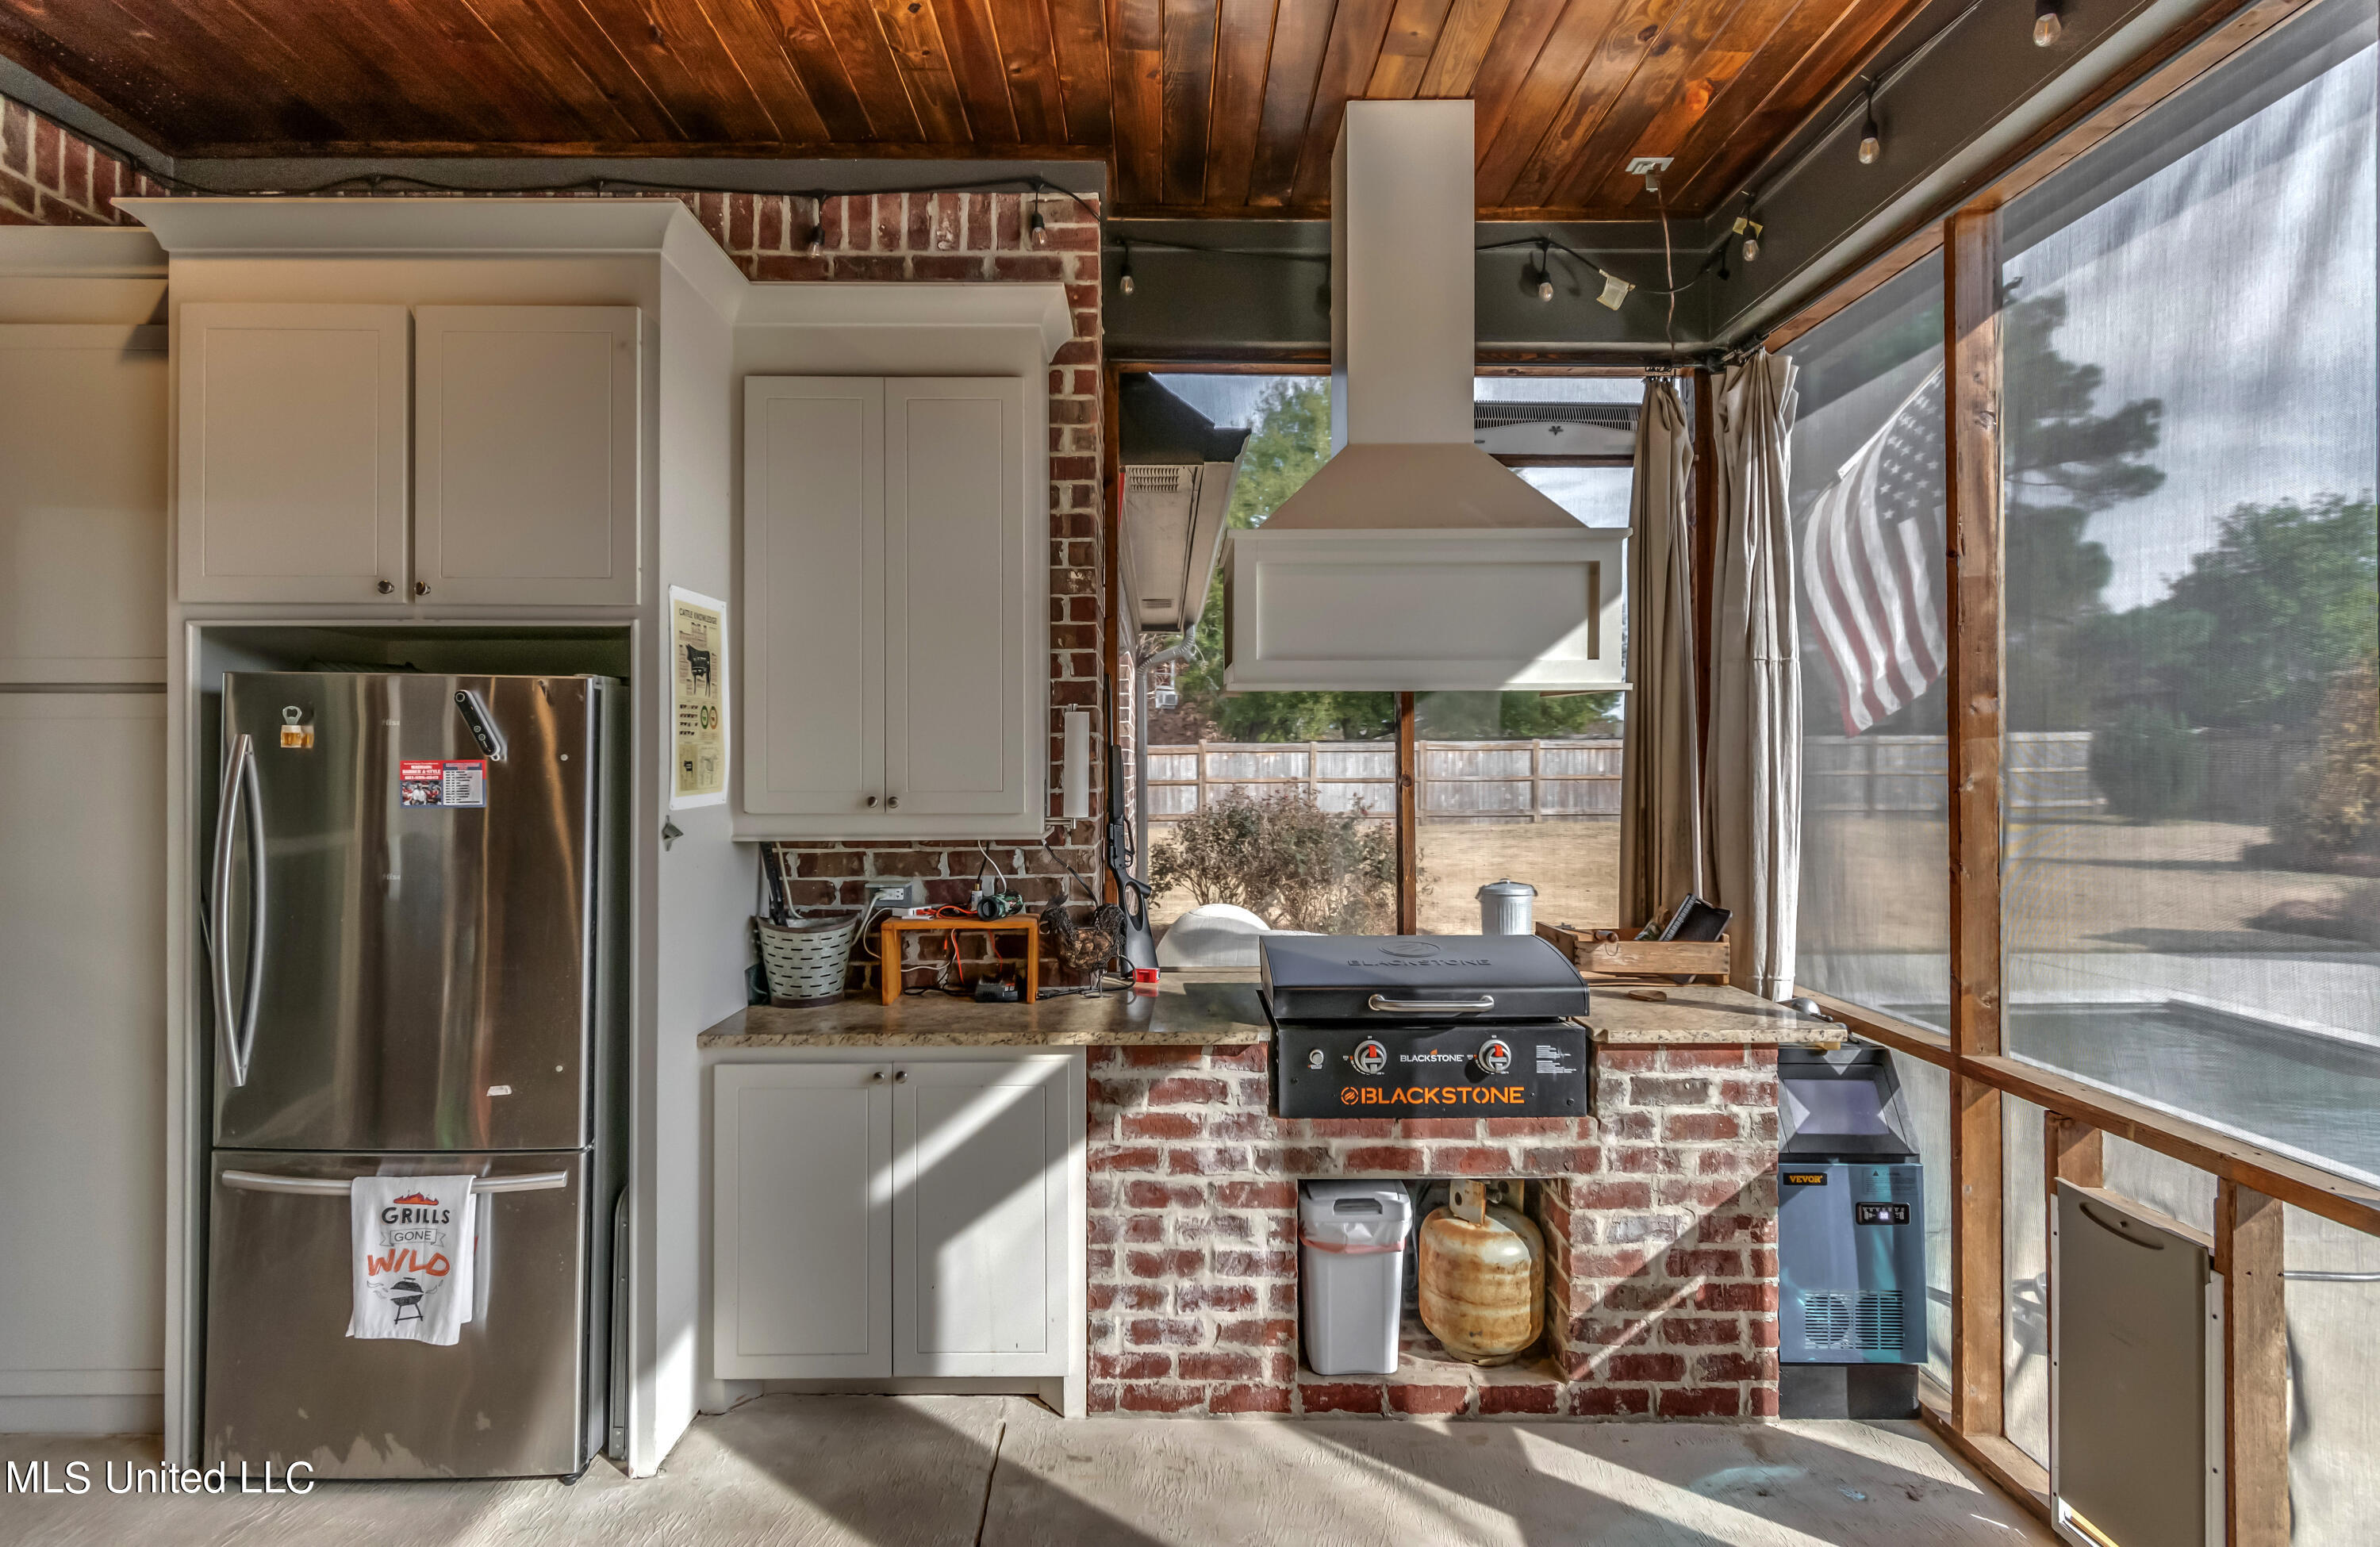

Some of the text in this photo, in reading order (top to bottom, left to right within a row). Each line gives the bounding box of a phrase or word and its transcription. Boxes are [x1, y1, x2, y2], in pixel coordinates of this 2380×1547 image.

[1361, 1087, 1525, 1104] BLACKSTONE
[382, 1207, 451, 1224] GRILLS
[394, 1230, 432, 1242] GONE
[367, 1248, 451, 1276] WILD
